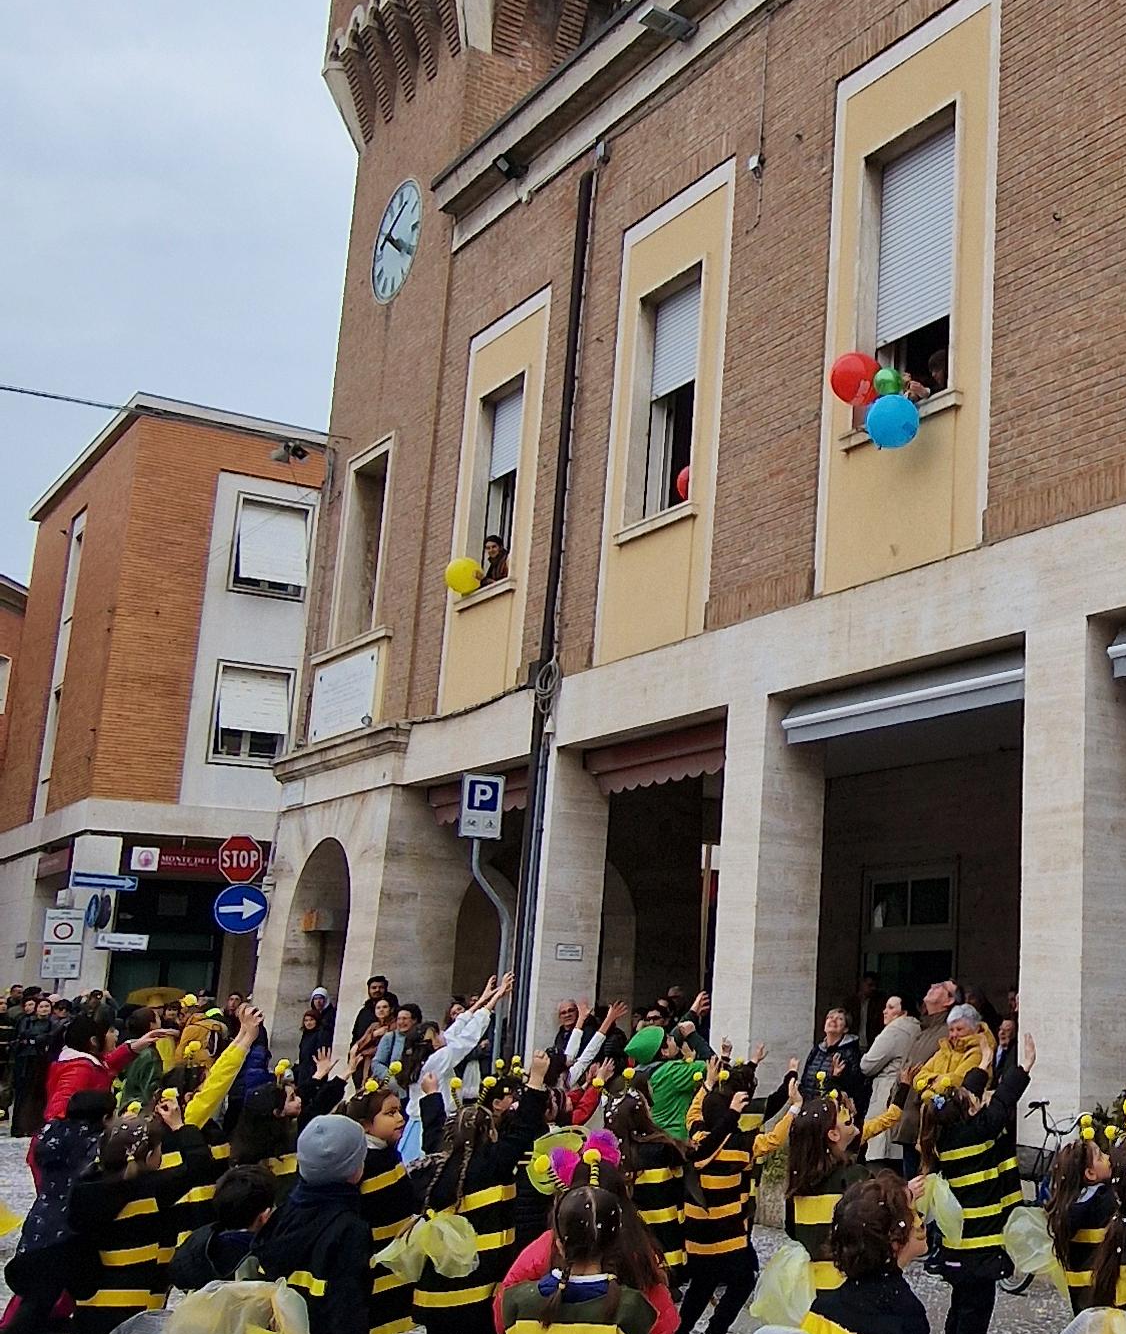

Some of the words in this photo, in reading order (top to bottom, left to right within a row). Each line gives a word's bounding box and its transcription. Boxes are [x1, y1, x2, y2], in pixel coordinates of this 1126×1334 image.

[473, 783, 493, 807] P
[161, 854, 192, 864] MONTE
[222, 850, 259, 868] STOP
